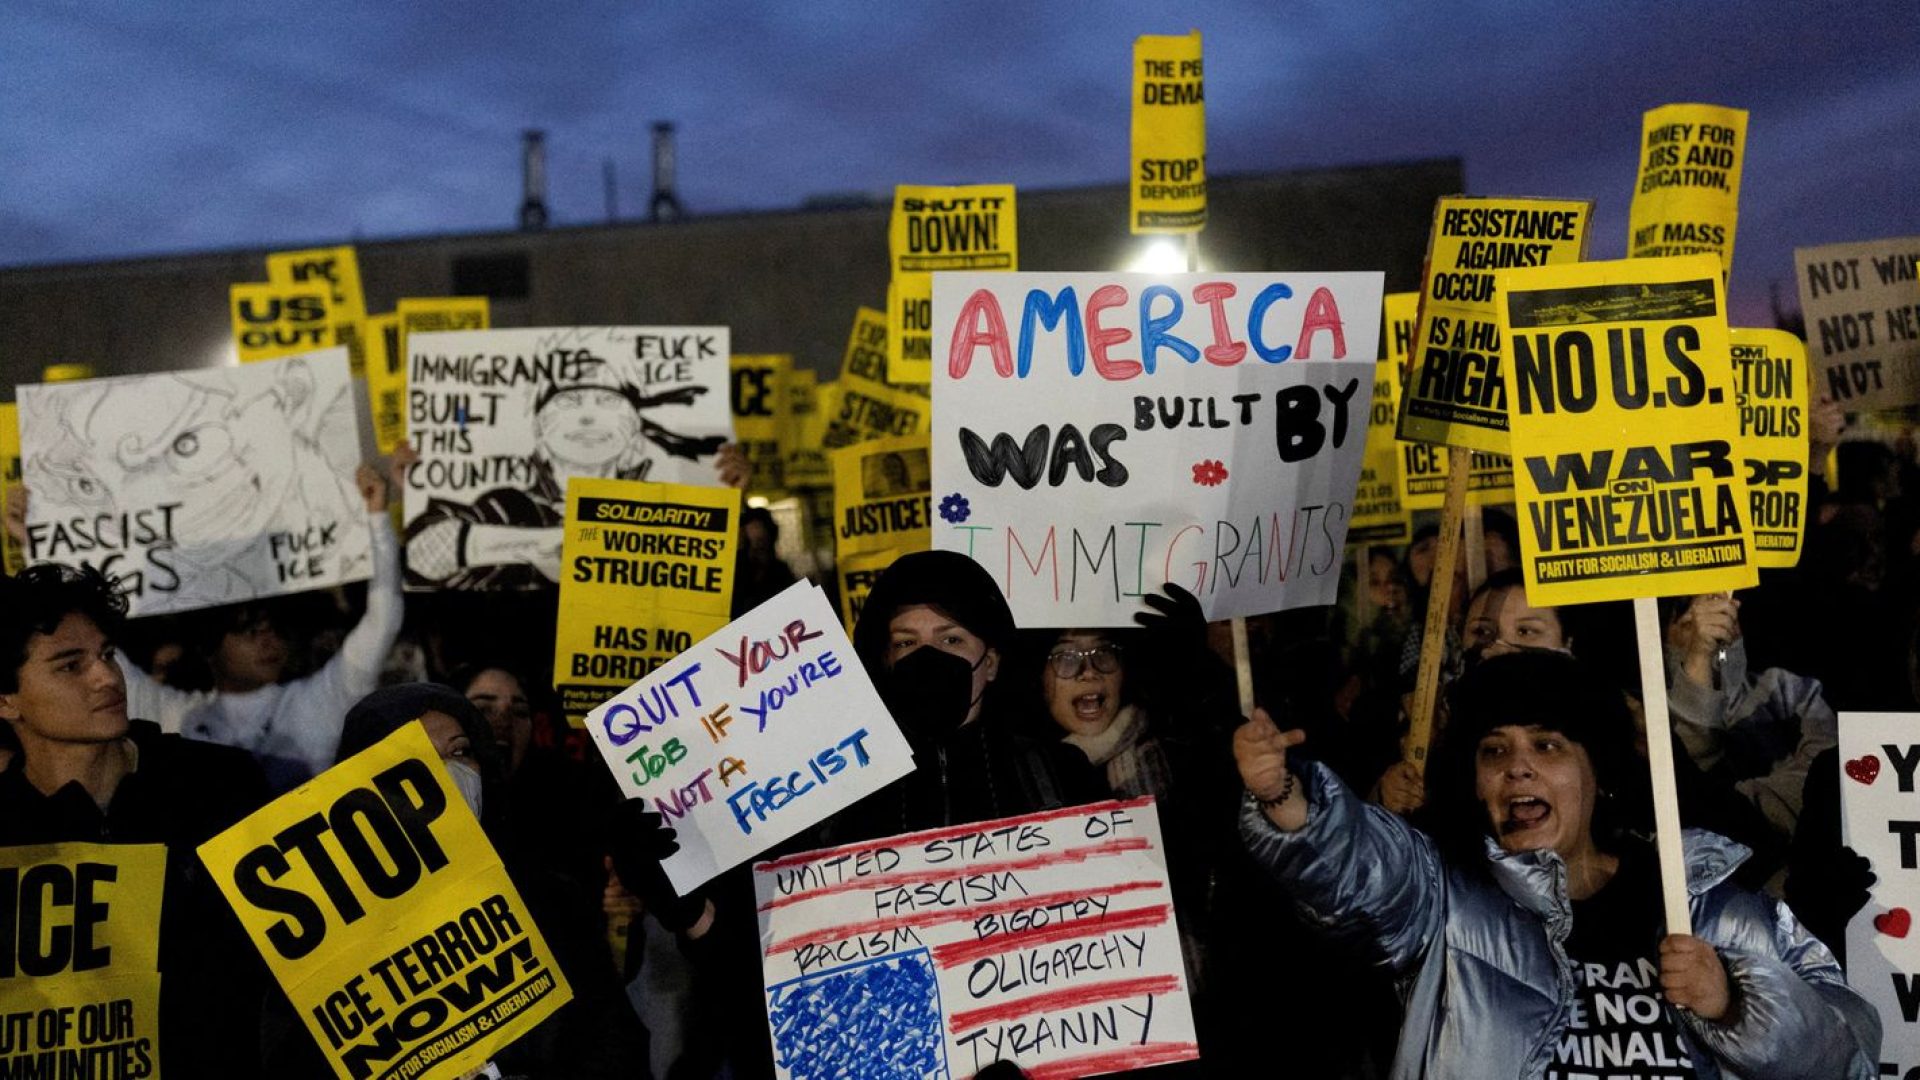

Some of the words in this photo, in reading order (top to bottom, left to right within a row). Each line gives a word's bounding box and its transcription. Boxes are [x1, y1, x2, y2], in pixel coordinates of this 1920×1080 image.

[1144, 60, 1175, 77] THE
[1699, 124, 1735, 146] FOR
[1141, 158, 1198, 182] STOP
[1686, 145, 1734, 169] AND
[903, 198, 976, 212] SHUT
[981, 198, 1005, 209] IT
[1442, 208, 1578, 241] RESISTANCE
[908, 213, 998, 253] DOWN!
[1663, 223, 1725, 245] MASS
[1455, 241, 1553, 270] AGAINST
[1808, 259, 1860, 298] NOT
[239, 297, 326, 323] US
[241, 327, 326, 347] OUT
[636, 335, 717, 361] FUCK
[948, 281, 1346, 380] AMERICA
[1428, 316, 1450, 345] IS
[1452, 319, 1466, 348] A
[1819, 312, 1875, 356] NOT
[644, 361, 694, 384] ICE
[1512, 330, 1597, 415] NO
[1607, 325, 1723, 410] U.S.
[1827, 360, 1883, 401] NOT
[410, 391, 506, 426] BUILT
[411, 427, 473, 455] THIS
[959, 424, 1129, 490] WAS
[1133, 394, 1261, 431] BUILT
[1276, 378, 1359, 463] BY
[408, 454, 537, 491] COUNTRY
[1404, 443, 1442, 475] ICE
[1523, 439, 1734, 494] WAR
[1613, 481, 1648, 493] ON
[27, 504, 183, 559] FASCIST
[595, 503, 710, 527] SOLIDARITY!
[841, 497, 923, 539] JUSTICE
[1528, 484, 1742, 552] VENEZUELA
[269, 521, 338, 559] FUCK
[953, 502, 1344, 603] IMMIGRANTS
[277, 553, 326, 582] ICE
[573, 556, 722, 593] STRUGGLE
[1538, 560, 1576, 579] PARTY
[1577, 558, 1600, 576] FOR
[1600, 553, 1658, 574] SOCIALISM
[1661, 552, 1675, 567] &
[1676, 544, 1742, 566] LIBERATION
[594, 625, 648, 650] HAS
[656, 628, 692, 653] NO
[603, 662, 702, 746] QUIT
[716, 619, 824, 688] YOUR
[625, 736, 688, 787] JOB
[700, 703, 733, 743] IF
[740, 651, 842, 732] YOU'RE
[718, 755, 747, 787] A
[726, 728, 869, 834] FASCIST
[654, 768, 713, 826] NOT
[233, 757, 449, 961] STOP
[776, 847, 901, 896] UNITED
[924, 825, 1051, 863] STATES
[1084, 811, 1134, 838] OF
[874, 872, 1029, 918] FASCISM
[0, 863, 117, 979] ICE
[973, 895, 1111, 941] BIGOTRY
[794, 926, 923, 974] RACISM
[968, 931, 1147, 998] OLIGARCHY
[312, 975, 385, 1051] ICE
[368, 894, 523, 1006] TERROR
[37, 1007, 74, 1049] OF
[78, 999, 133, 1045] OUR
[341, 936, 540, 1080] NOW!
[420, 1021, 480, 1065] SOCIALISM
[477, 1015, 495, 1031] &
[490, 974, 551, 1024] LIBERATION
[956, 994, 1154, 1072] TYRANNY
